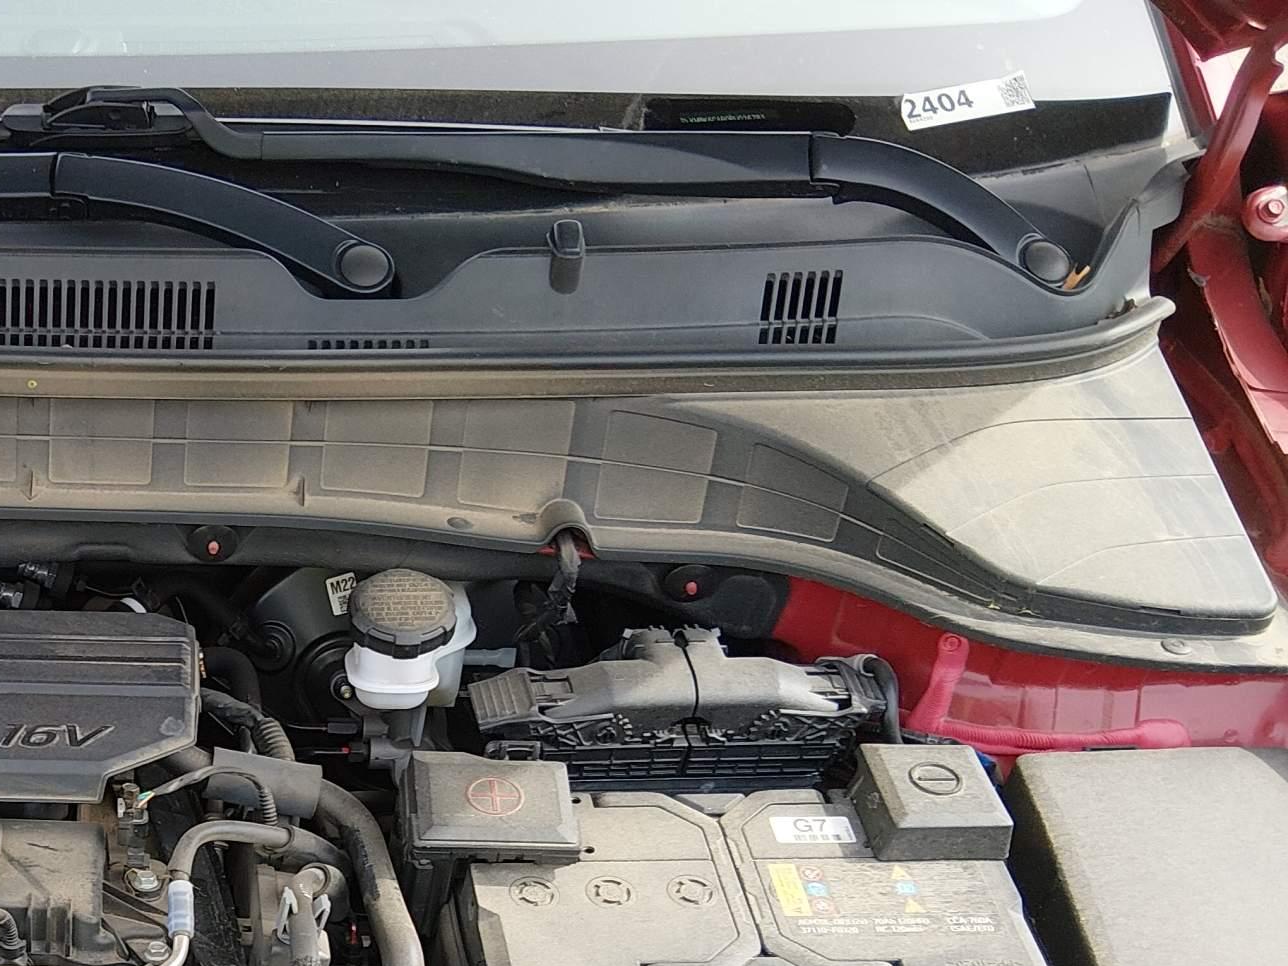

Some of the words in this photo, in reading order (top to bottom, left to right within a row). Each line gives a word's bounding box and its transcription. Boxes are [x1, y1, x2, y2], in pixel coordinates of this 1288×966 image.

[904, 90, 974, 119] 2404
[0, 722, 115, 749] 16V
[793, 818, 827, 833] G7
